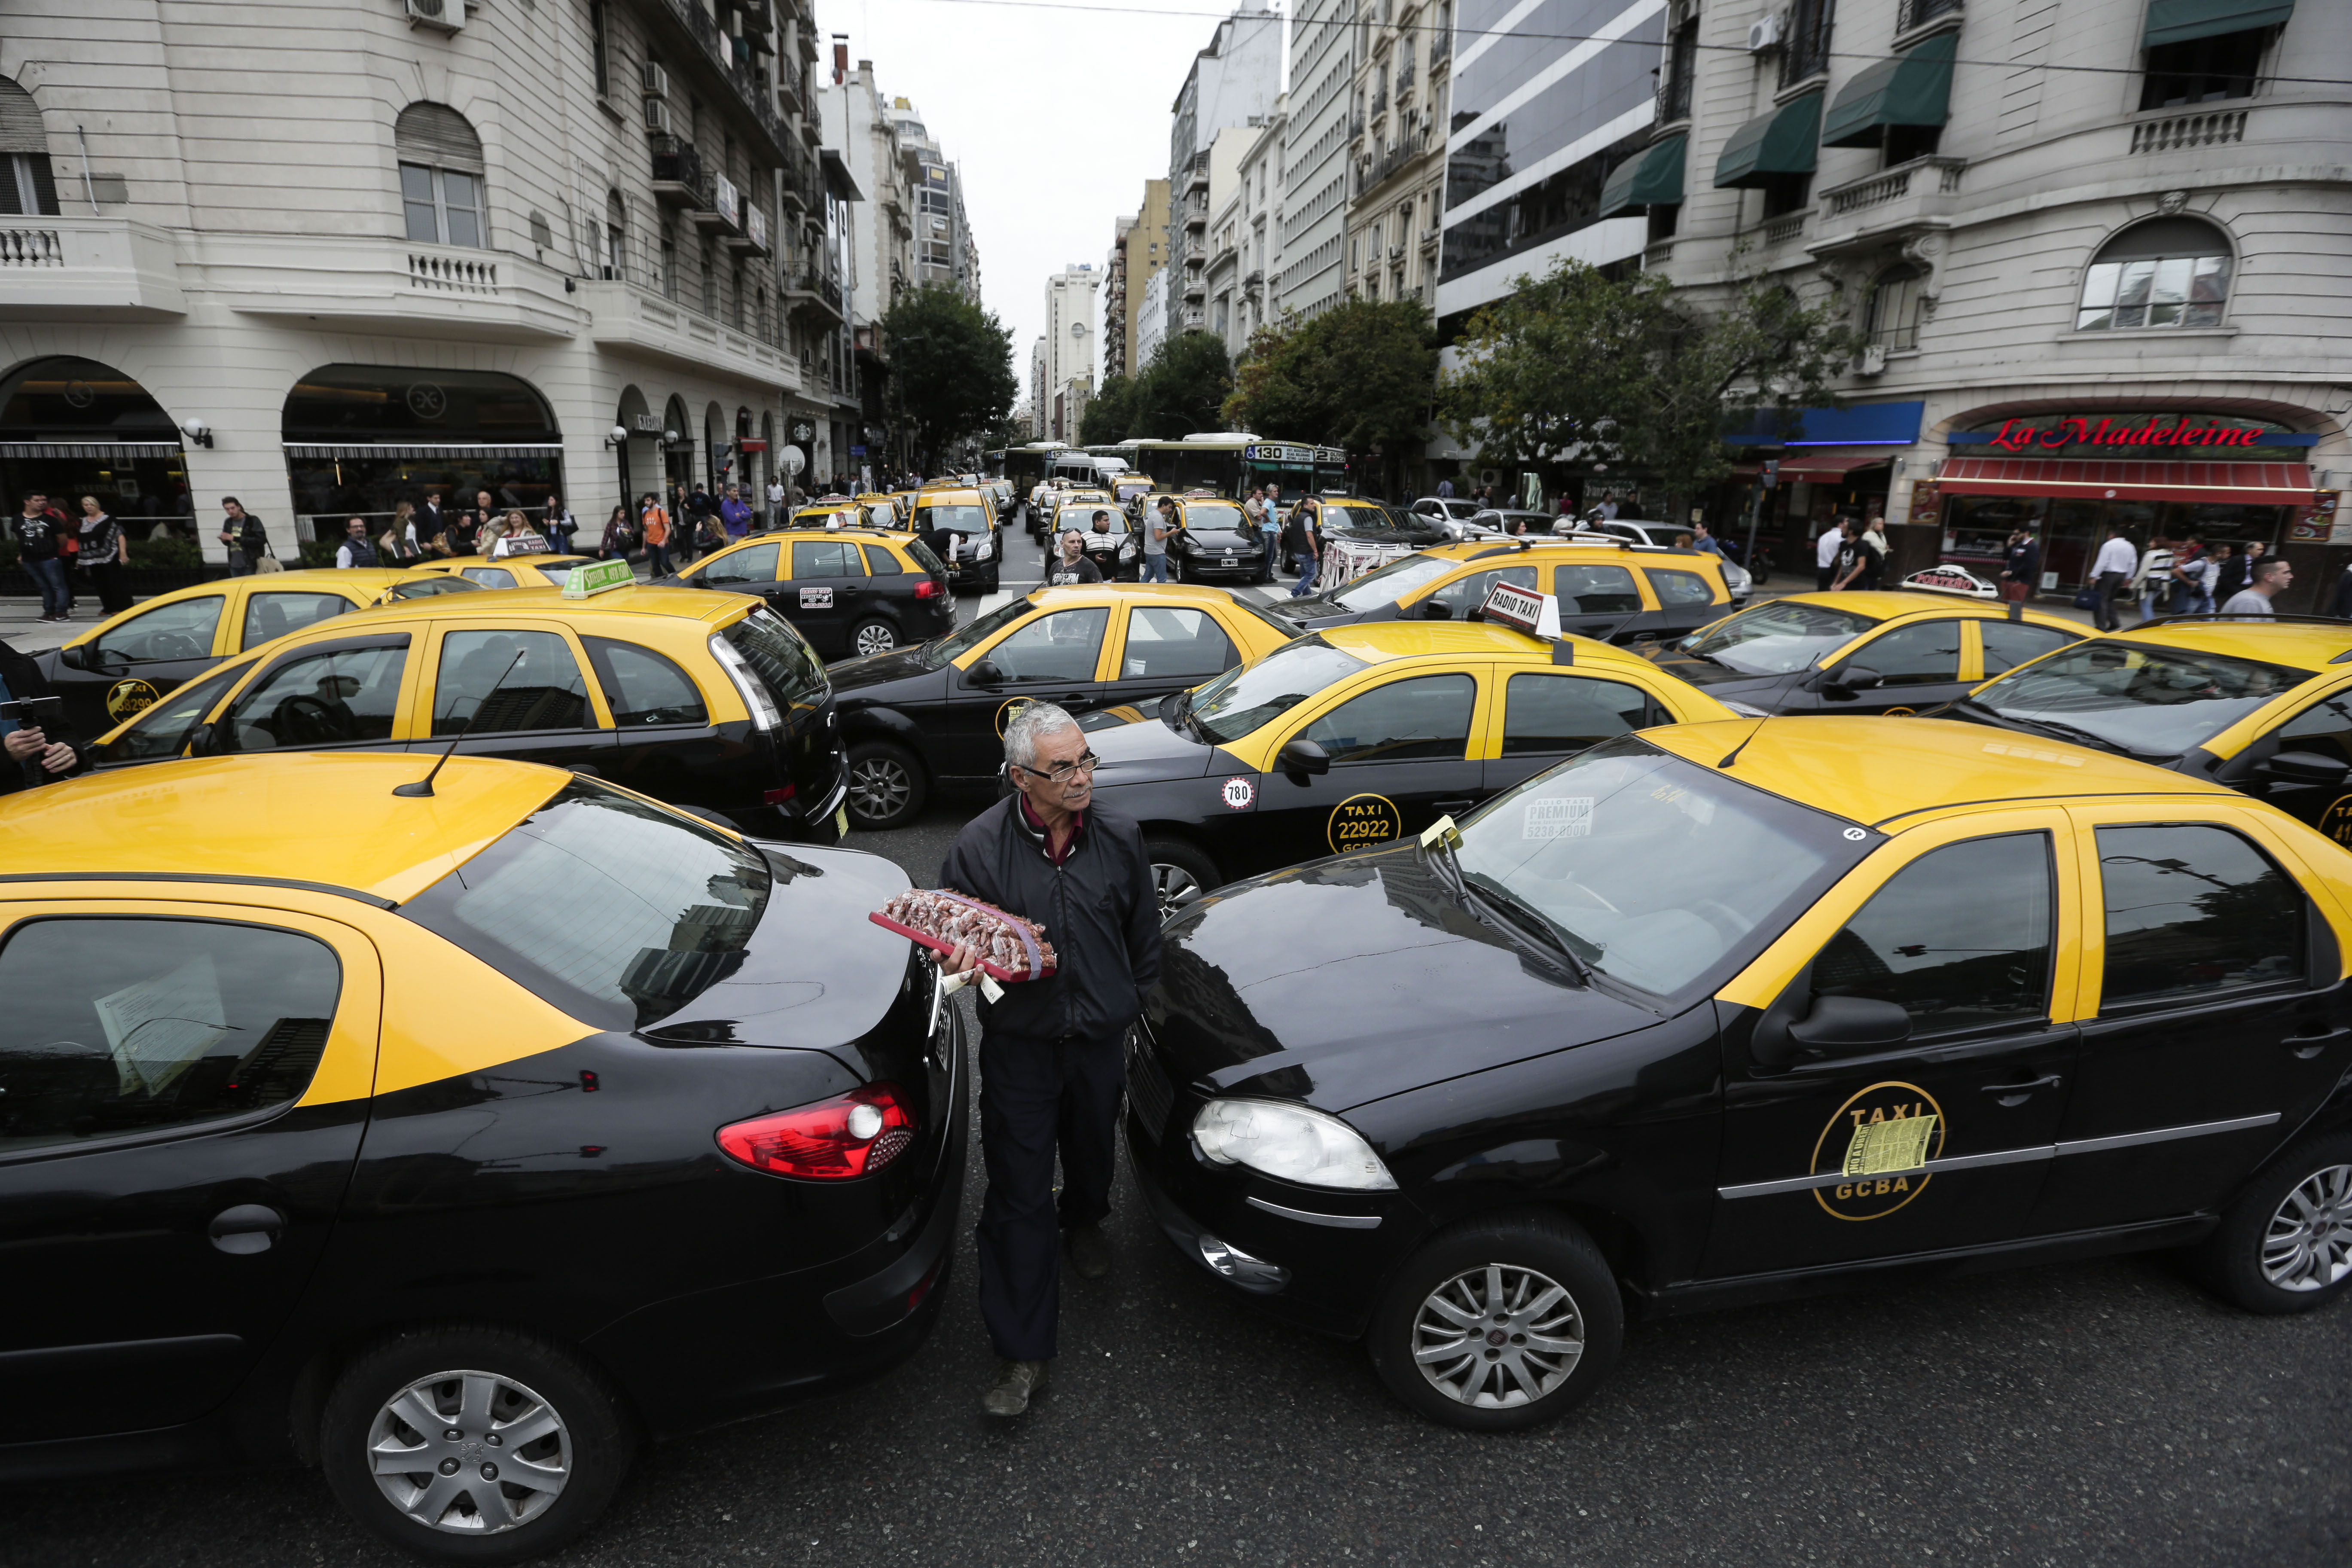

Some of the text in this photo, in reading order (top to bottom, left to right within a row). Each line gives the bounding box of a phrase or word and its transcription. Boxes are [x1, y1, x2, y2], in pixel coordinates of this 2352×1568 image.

[1989, 418, 2264, 451] La Madeleine
[1257, 447, 1282, 458] 130
[1915, 574, 1973, 590] PORTEÑO
[1492, 592, 1538, 619] RADIO TAXI
[1228, 786, 1248, 800] 780
[1345, 805, 1382, 816] TAXI
[1530, 805, 1589, 820] PREMIUM
[2335, 807, 2352, 817] TA
[1338, 820, 1389, 839] 22922
[1527, 825, 1586, 838] 5238-0000
[1343, 842, 1378, 853] GC
[1850, 1102, 1922, 1127] TAXI
[1836, 1176, 1909, 1200] GCBA
